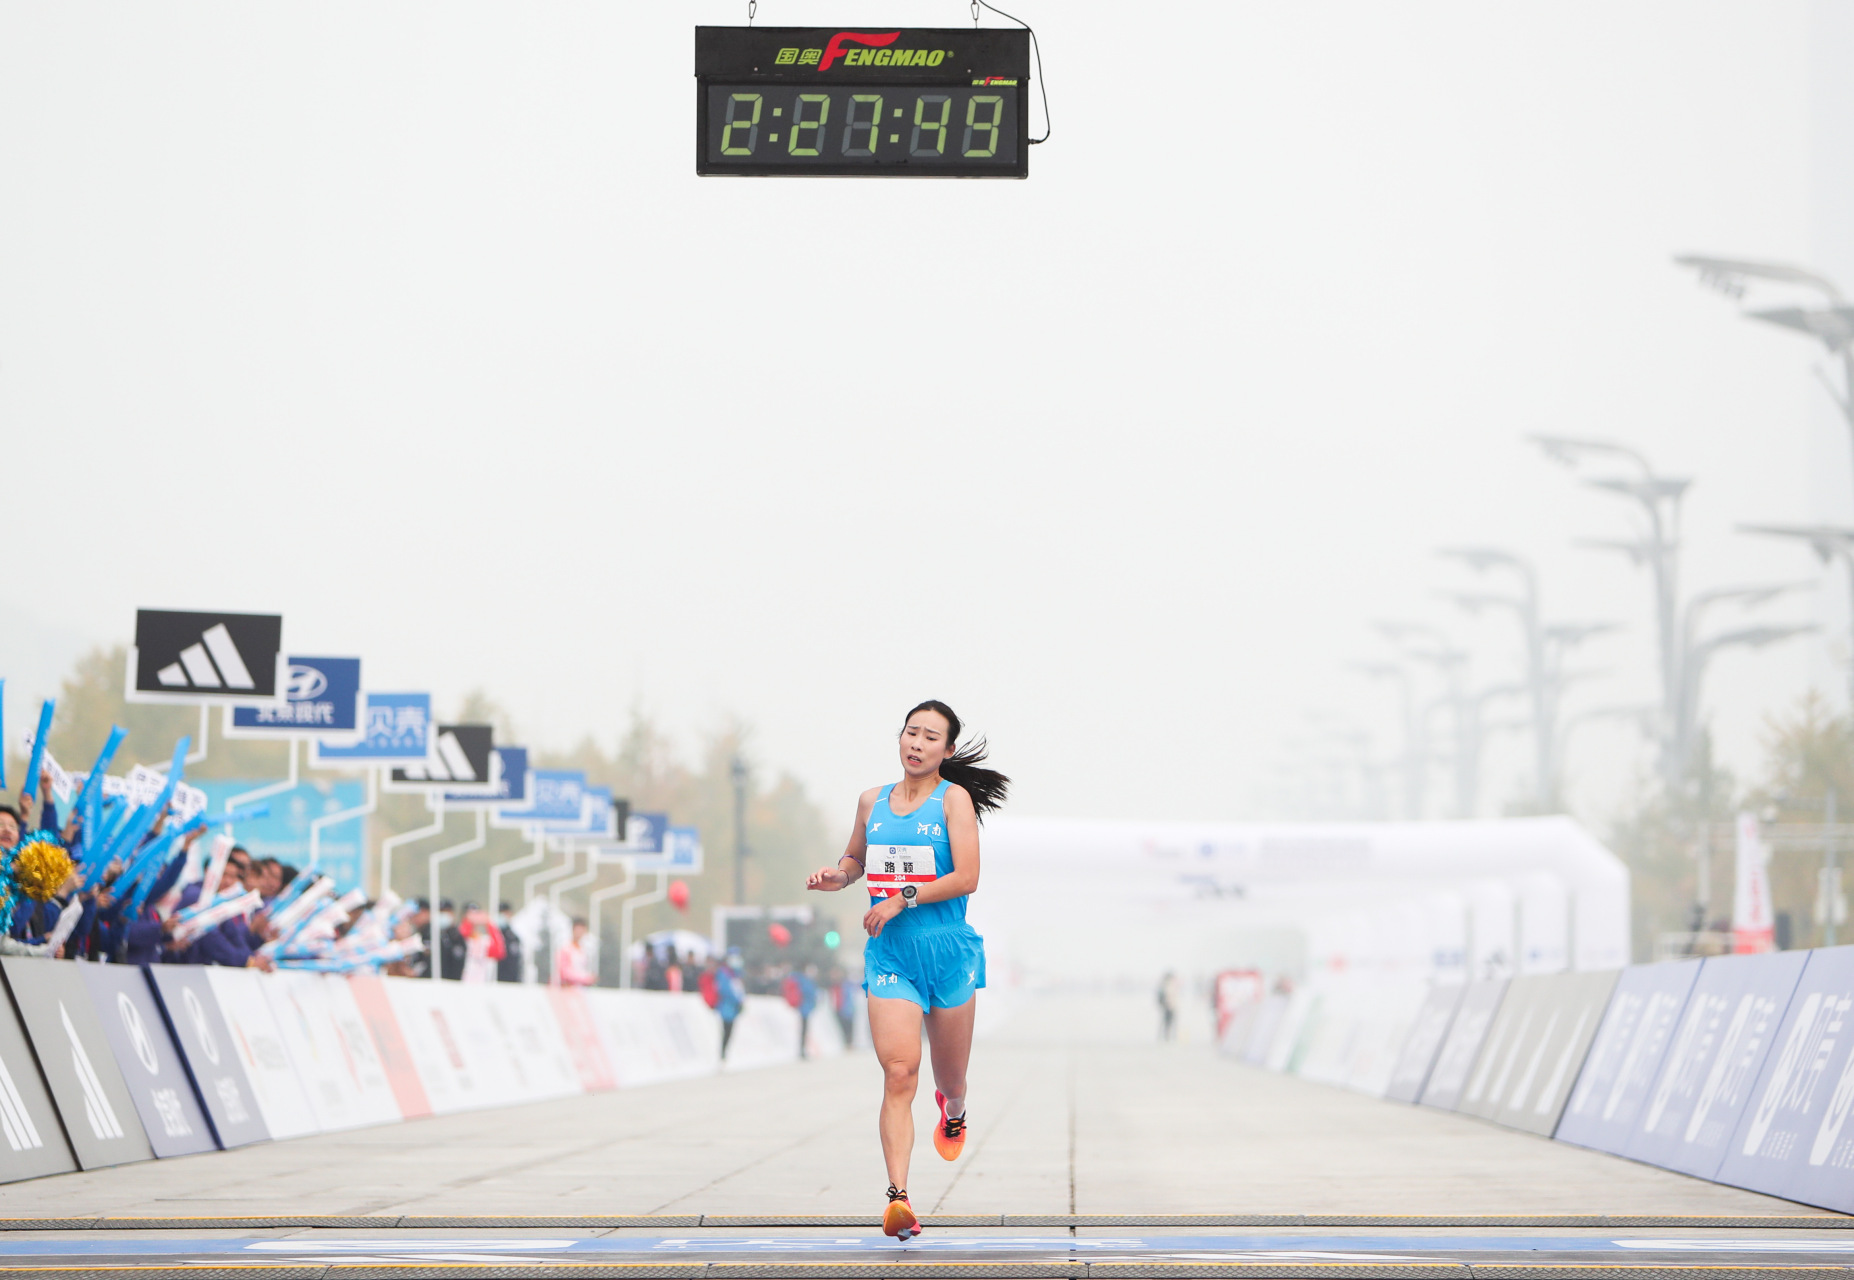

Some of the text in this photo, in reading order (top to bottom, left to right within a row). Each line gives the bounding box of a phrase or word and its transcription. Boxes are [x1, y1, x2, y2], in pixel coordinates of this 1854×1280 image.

[775, 48, 822, 65] 国奥
[720, 93, 1004, 158] 2:27:49
[368, 706, 427, 738] 贝壳
[917, 822, 941, 836] 河南
[876, 973, 898, 986] 河南
